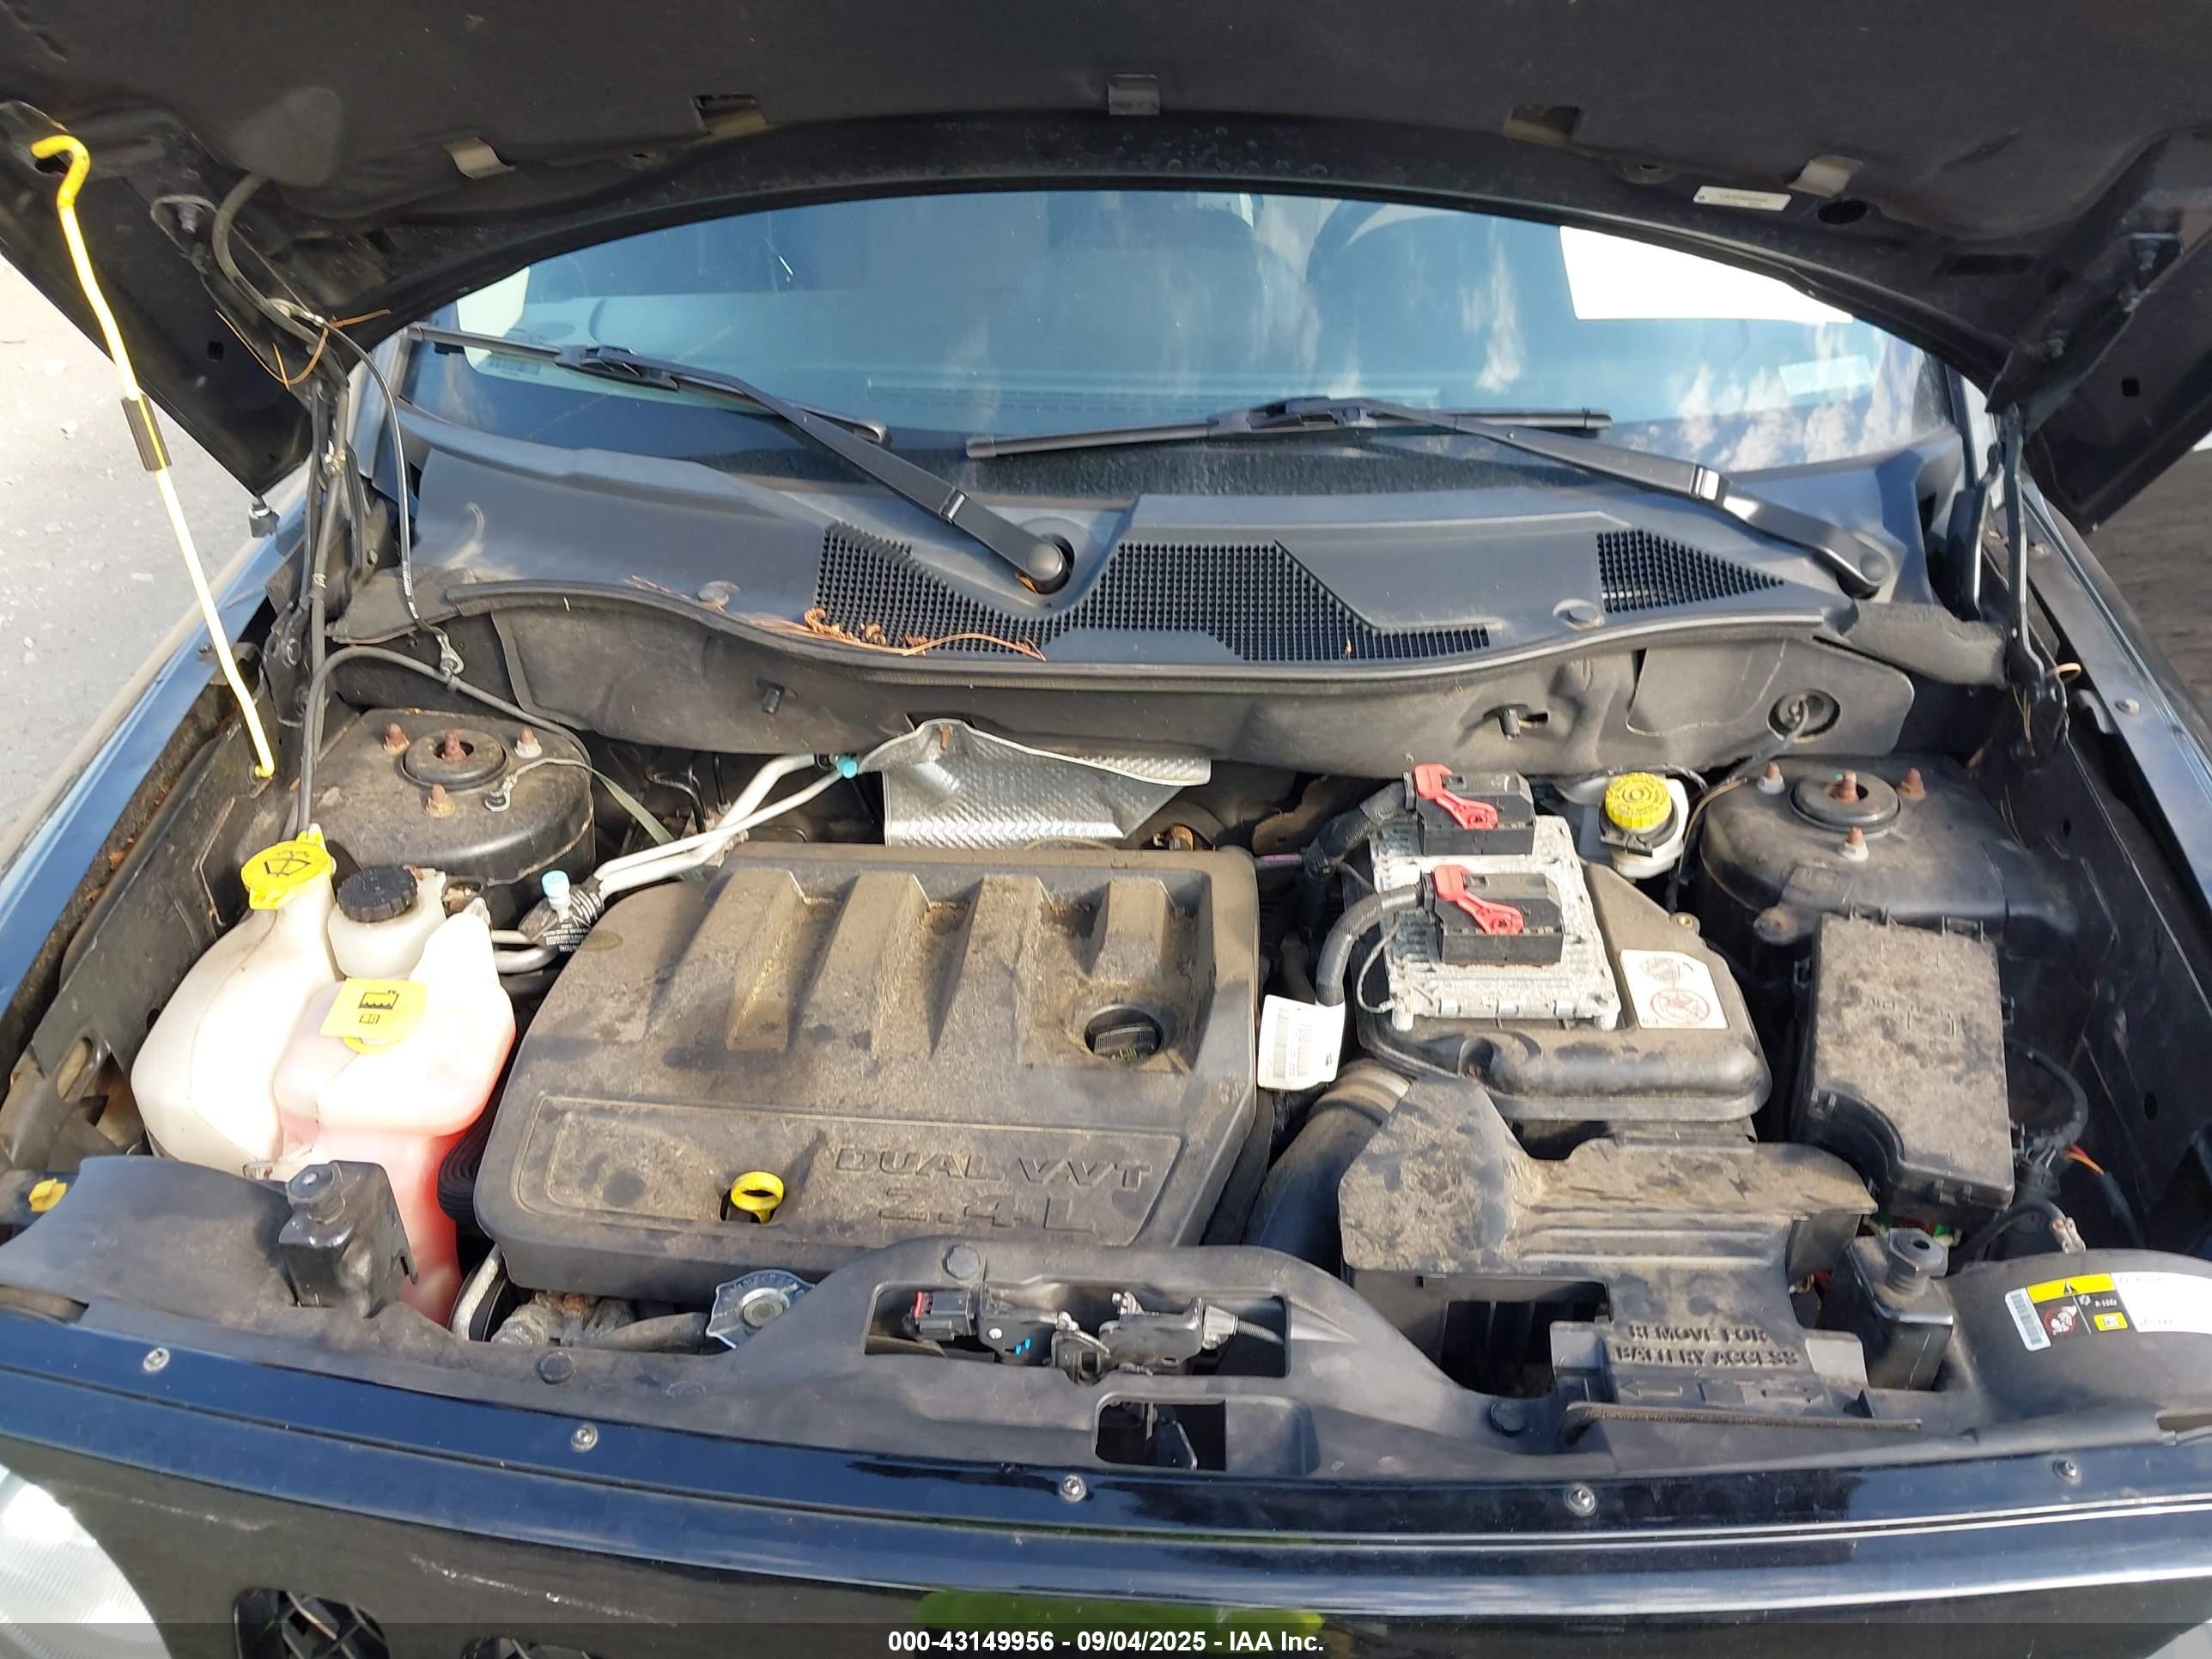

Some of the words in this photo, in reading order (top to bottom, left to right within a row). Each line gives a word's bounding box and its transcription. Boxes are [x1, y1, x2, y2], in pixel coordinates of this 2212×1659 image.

[835, 1146, 1004, 1182] DUAL
[1018, 1155, 1152, 1192] VVT
[878, 1187, 1096, 1234] 2.4L
[1628, 1325, 1720, 1343] REMOVE
[1721, 1327, 1767, 1343] FOR
[1615, 1346, 1708, 1365] BATTERY
[1712, 1350, 1799, 1367] ACCESS
